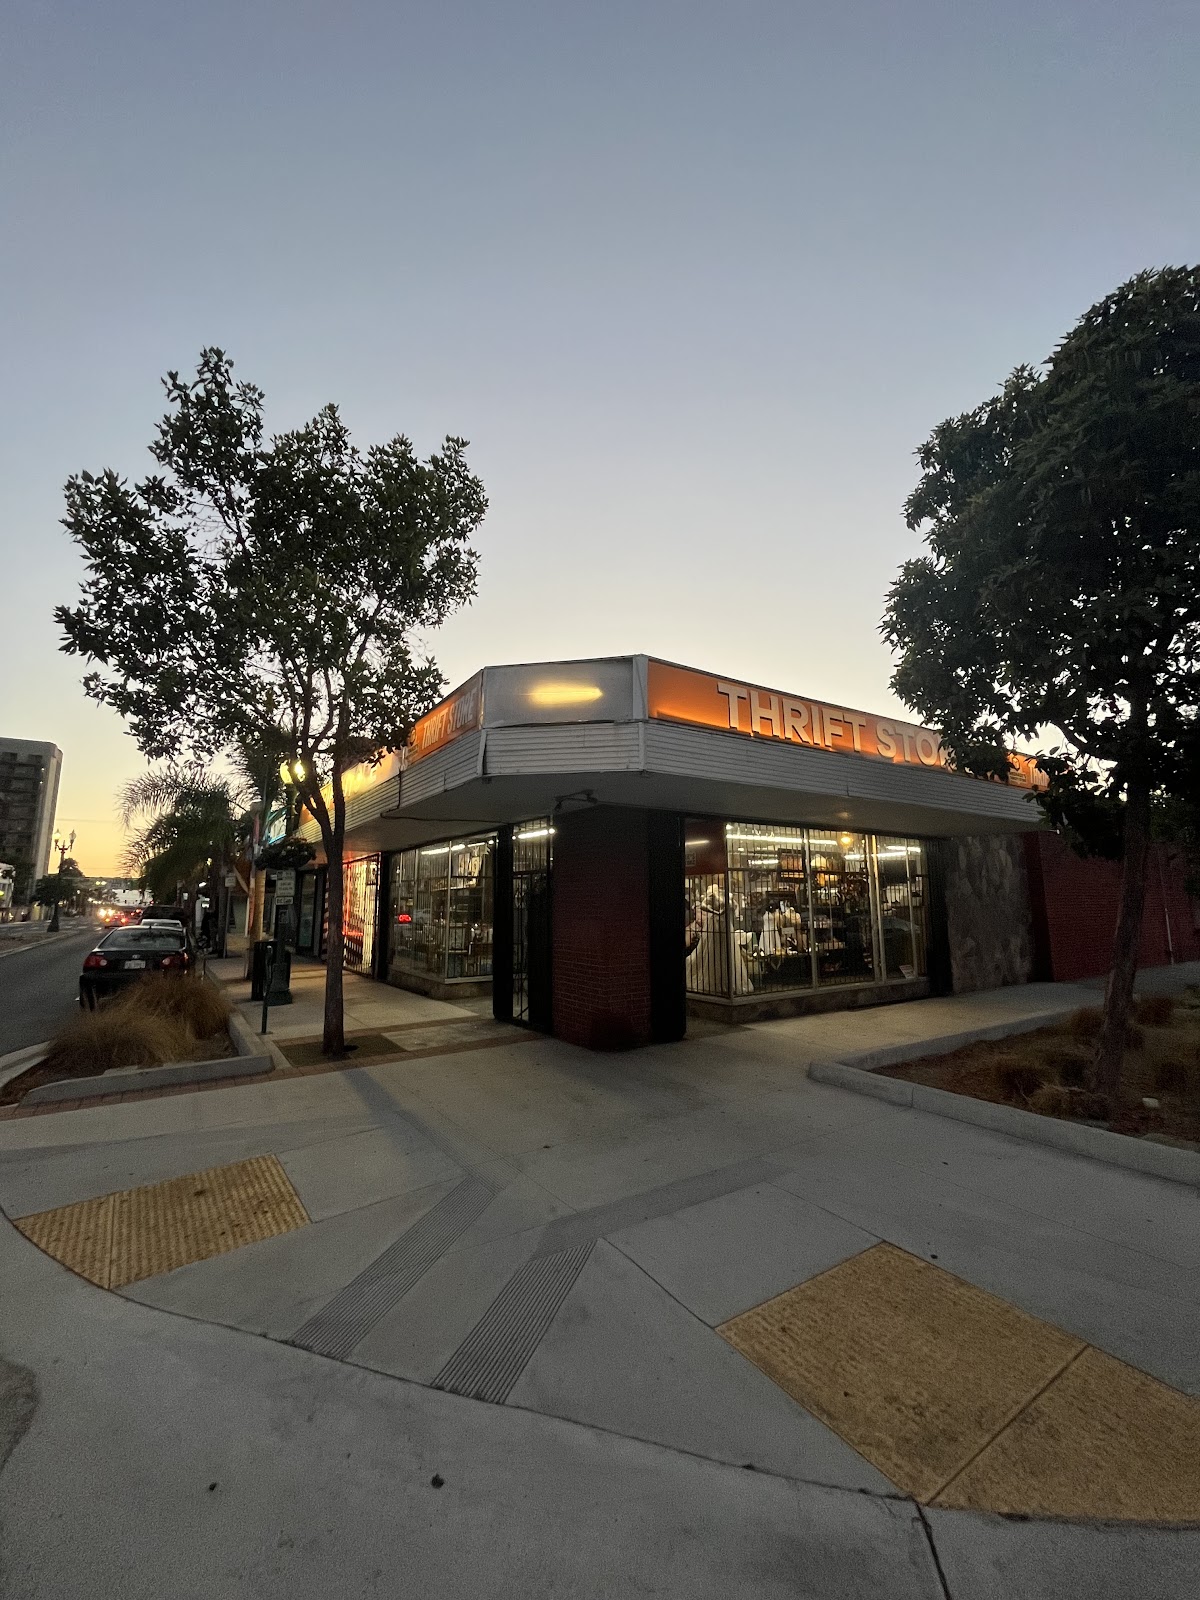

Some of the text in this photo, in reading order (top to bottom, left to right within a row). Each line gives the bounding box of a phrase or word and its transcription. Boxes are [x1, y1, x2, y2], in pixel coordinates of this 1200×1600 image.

[422, 687, 478, 750] THRIFT STORE
[717, 681, 960, 772] THRIFT STO
